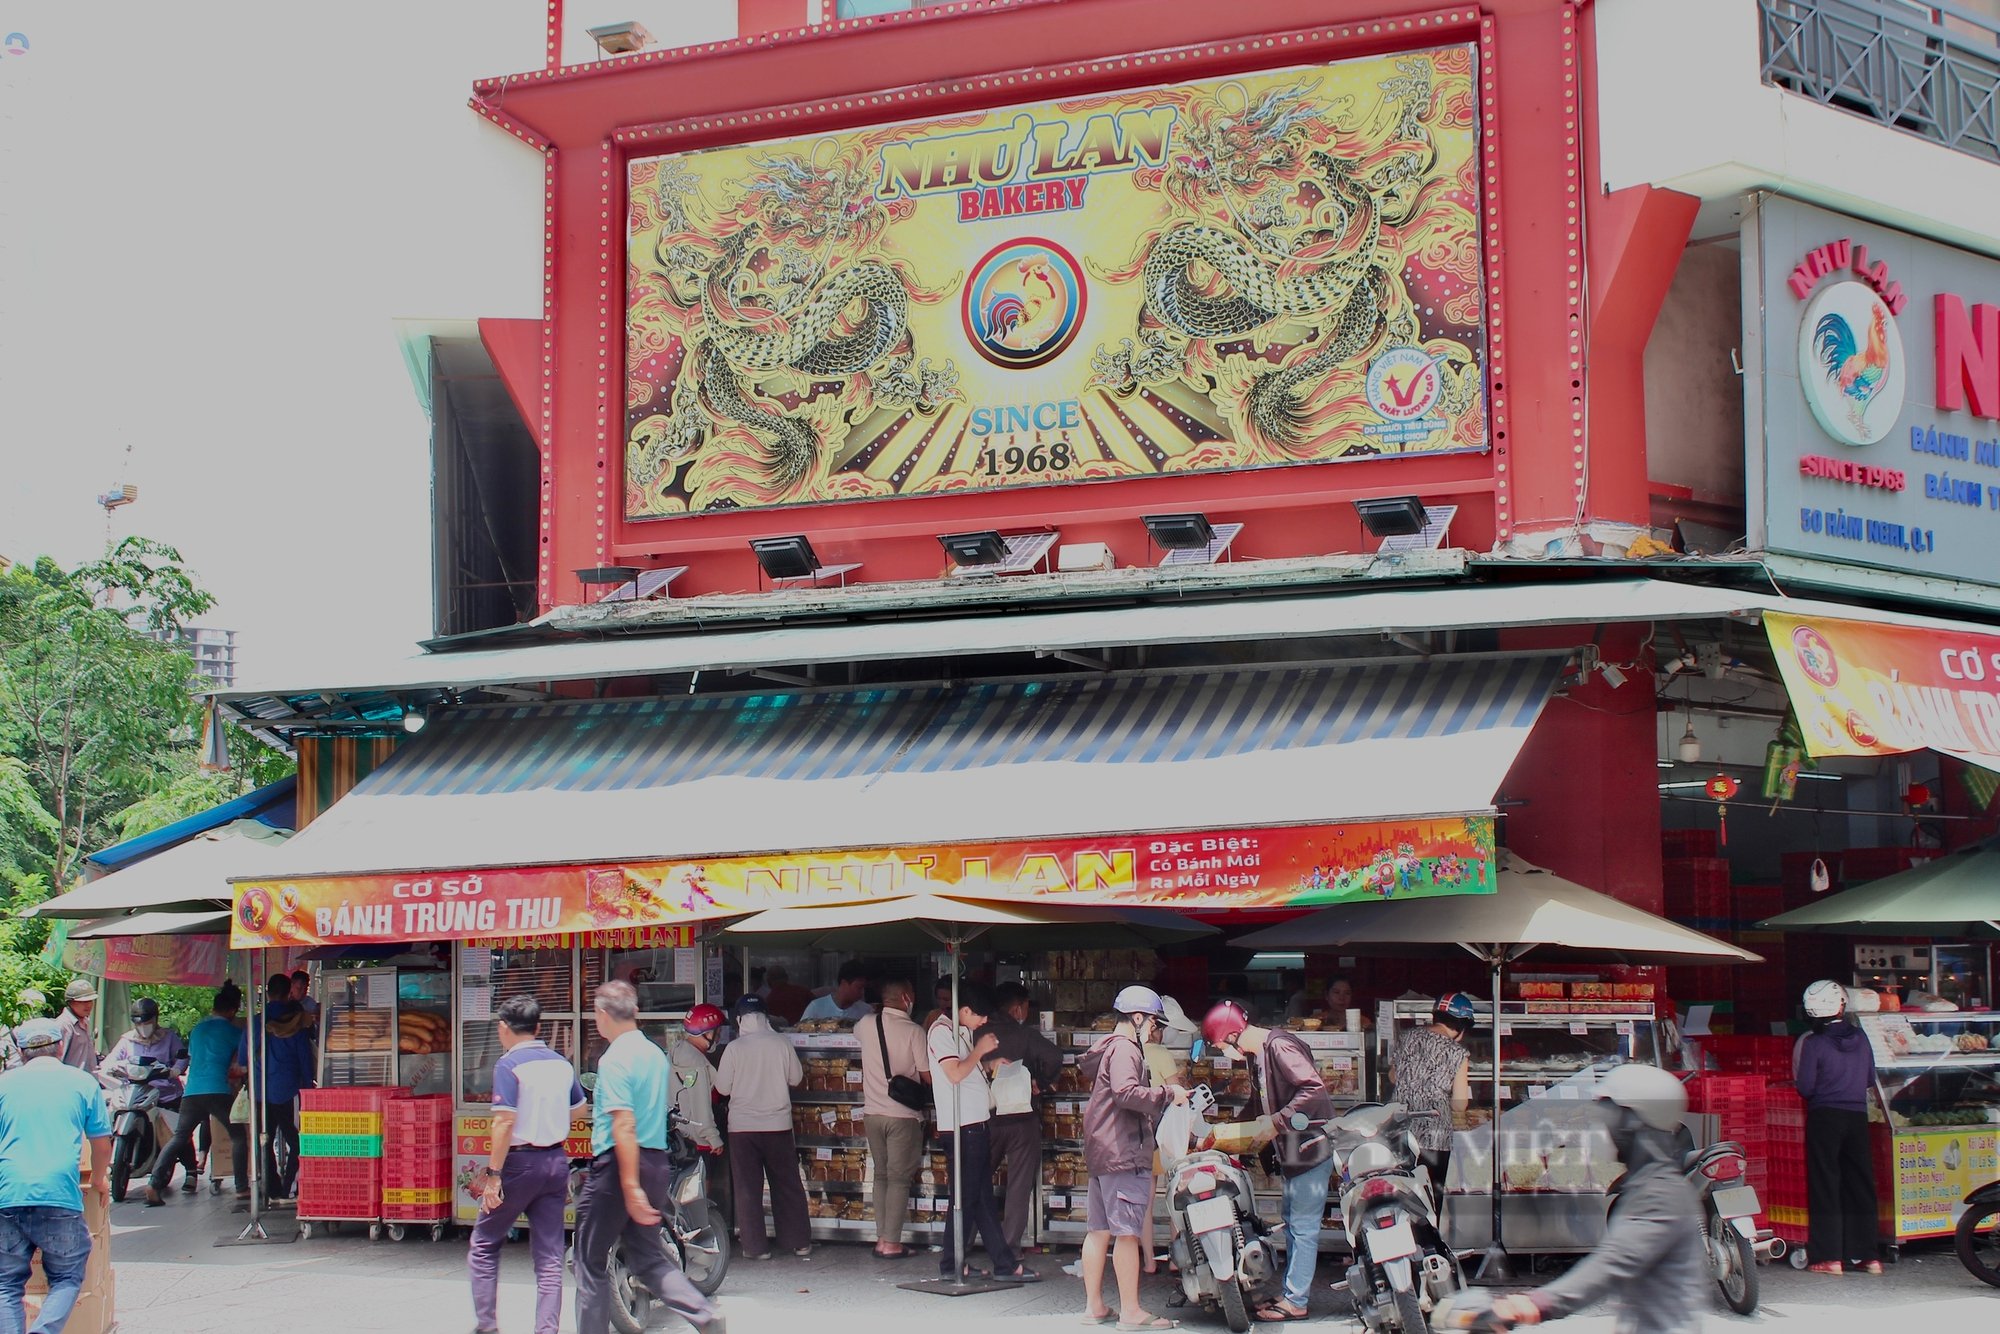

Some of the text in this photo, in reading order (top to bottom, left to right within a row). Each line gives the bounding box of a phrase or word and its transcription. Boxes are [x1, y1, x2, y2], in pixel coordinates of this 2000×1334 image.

[876, 106, 1177, 200] NHƯ LAN
[958, 176, 1088, 222] BAKERY
[1851, 243, 1908, 317] LAN
[1400, 353, 1424, 366] NAM
[1934, 292, 2000, 421] N
[1425, 373, 1434, 392] CAO
[970, 401, 1080, 436] SINCE
[1364, 426, 1376, 434] DO
[1911, 424, 1969, 461] BÁNH
[984, 443, 1071, 477] 1968
[1800, 454, 1905, 493] SINCE 1968
[1925, 471, 2000, 511] BÁNH T
[1801, 507, 1823, 534] 50
[1825, 508, 1863, 541] HÀM
[1940, 647, 1984, 682] CƠ
[1150, 837, 1258, 855] Đặc Biệt:
[1150, 853, 1260, 872] Có Bánh Mới
[393, 874, 483, 898] CƠ SỞ
[1150, 872, 1260, 889] Ra Mỗi Ngày
[315, 896, 562, 937] BÁNH TRUNG THU
[640, 926, 679, 946] LAN
[463, 1118, 488, 1130] HEO
[570, 1120, 587, 1132] EO
